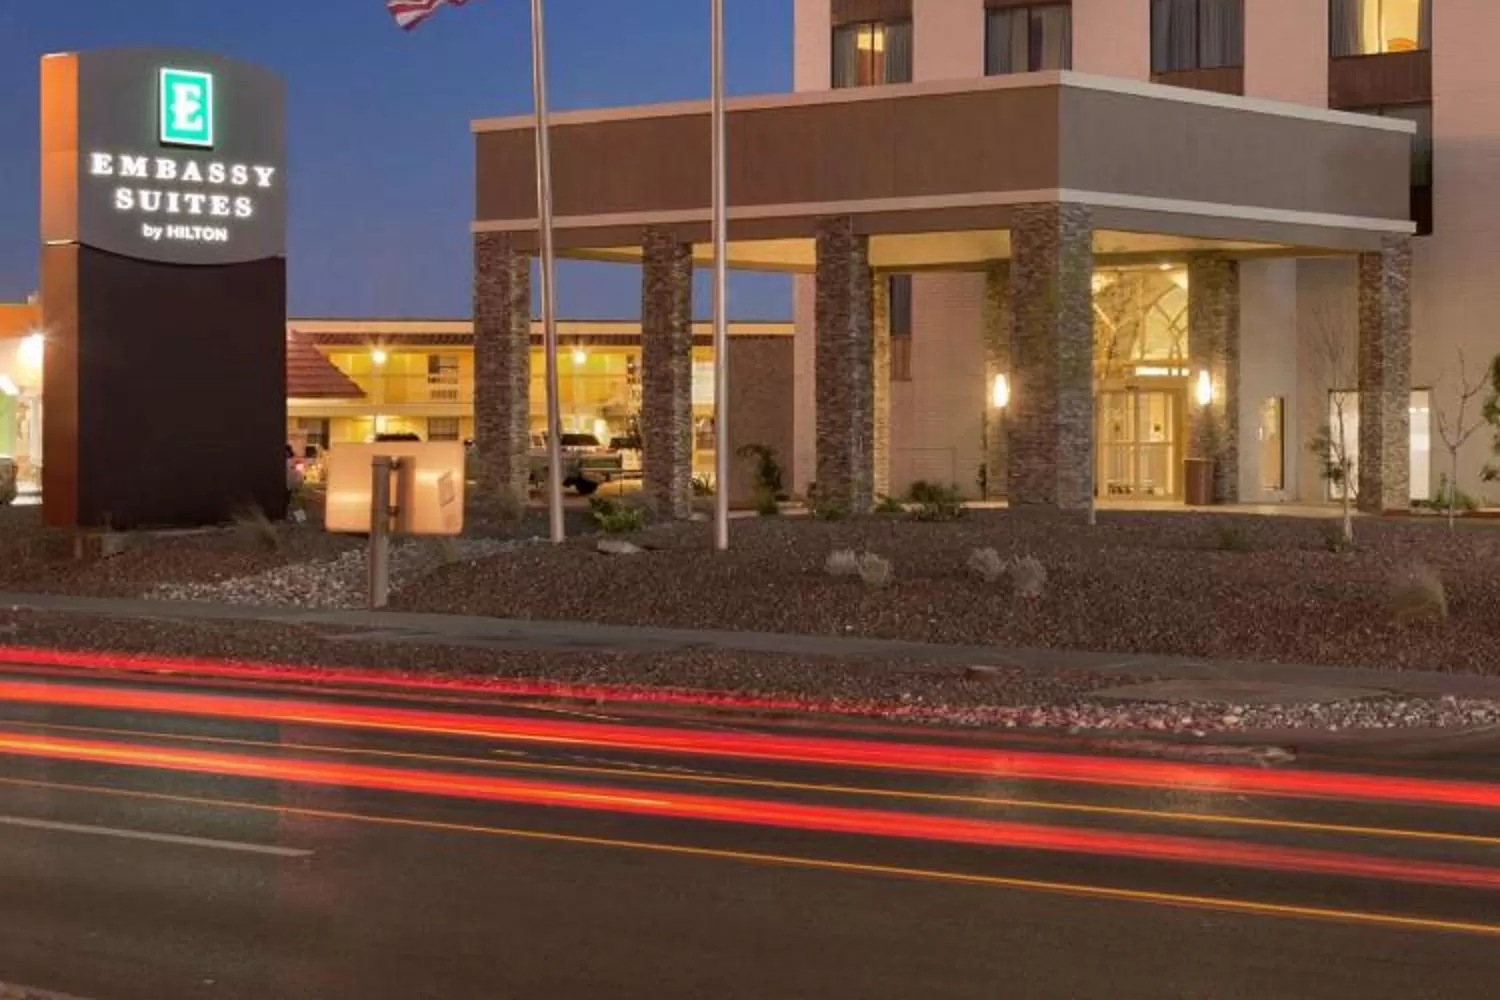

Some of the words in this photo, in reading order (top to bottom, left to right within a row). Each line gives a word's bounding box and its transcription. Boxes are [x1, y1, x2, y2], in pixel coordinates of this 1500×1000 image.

[171, 83, 203, 131] E
[91, 152, 275, 187] EMBASSY
[115, 187, 253, 217] SUITES
[142, 223, 163, 240] by
[167, 225, 228, 242] HILTON
